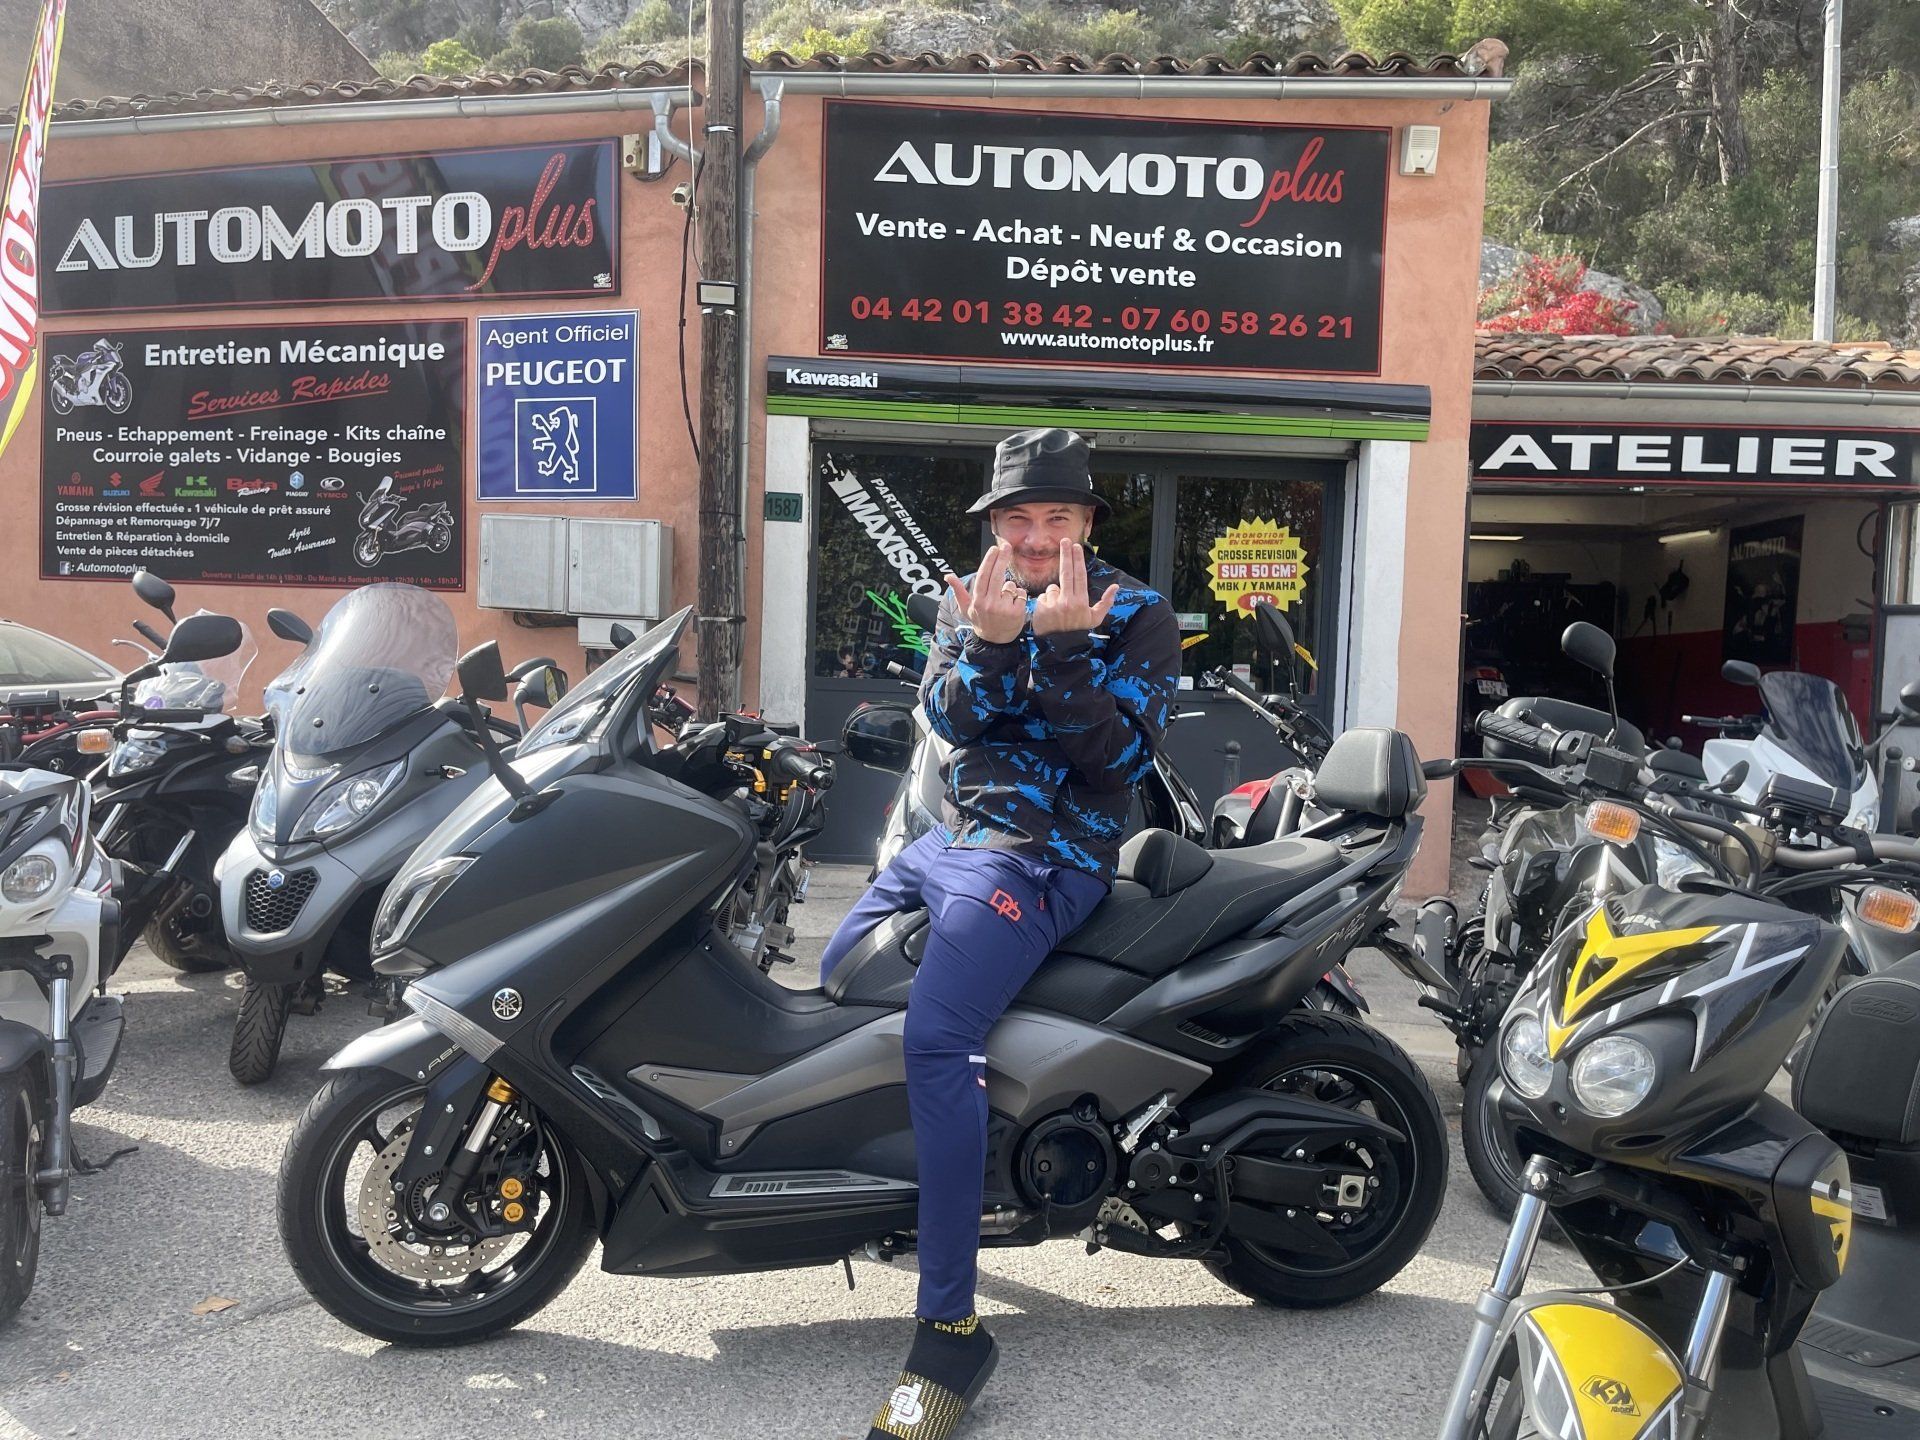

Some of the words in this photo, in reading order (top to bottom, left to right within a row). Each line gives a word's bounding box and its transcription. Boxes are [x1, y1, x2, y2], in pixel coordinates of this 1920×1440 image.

[873, 140, 1264, 201] AUTOMOTO
[1239, 136, 1343, 228] plus
[55, 191, 493, 273] AUTOMOTO
[463, 152, 597, 292] plus
[856, 212, 946, 240] Vente
[972, 219, 1063, 247] Achat
[1090, 223, 1165, 251] Neuf
[1174, 227, 1197, 253] &
[1205, 228, 1343, 259] Occasion
[1006, 254, 1103, 287] Dépôt
[1110, 262, 1197, 289] vente
[851, 296, 892, 321] 04
[901, 299, 943, 322] 42
[952, 300, 989, 324] 01
[1002, 302, 1042, 326] 38
[1052, 304, 1093, 328] 42
[1121, 306, 1160, 332] 07
[1170, 309, 1211, 334] 60
[1220, 311, 1259, 336] 58
[1269, 313, 1308, 338] 26
[1317, 315, 1354, 339] 21
[486, 328, 549, 349] Agent
[555, 323, 629, 343] Officiel
[1001, 330, 1215, 356] www.automotoplus.fr
[145, 341, 270, 366] Entretien
[280, 337, 445, 368] Mécanique
[486, 358, 627, 387] PEUGEOT
[786, 367, 879, 388] Kawasaki
[188, 389, 281, 415] Services
[291, 370, 391, 401] Rapides
[56, 427, 103, 442] Pneus
[118, 426, 233, 445] Echappement
[251, 426, 328, 444] Freinage
[346, 425, 380, 441] Kits
[387, 424, 446, 441] chaîne
[93, 448, 164, 463] Courroie
[169, 448, 221, 467] galets
[237, 448, 310, 467] Vidange
[328, 448, 402, 467] Bougies
[1479, 434, 1897, 478] ATELIER
[57, 485, 95, 497] YAMAHA
[103, 489, 131, 497] SUZUKI
[175, 487, 217, 498] Kawasaki
[56, 503, 90, 513] Grosse
[93, 503, 133, 513] révision
[135, 502, 185, 514] effectuée
[194, 504, 200, 513] 1
[204, 504, 248, 514] véhicule
[251, 505, 266, 514] de
[269, 504, 292, 518] prêt
[295, 505, 331, 515] assuré
[768, 498, 799, 517] 1587
[56, 516, 114, 529] Dépannage
[117, 518, 127, 526] et
[130, 517, 197, 529] Remorquage
[200, 517, 221, 530] 7j/7
[870, 477, 938, 555] PARTENAIRE
[931, 558, 955, 573] AV
[56, 531, 102, 542] Entretien
[105, 532, 113, 541] &
[117, 531, 173, 544] Réparation
[176, 533, 183, 543] à
[185, 533, 230, 543] domicile
[267, 549, 292, 559] Toutes
[294, 537, 336, 553] Assurances
[840, 490, 945, 601] MAXISCO
[57, 546, 87, 556] Vente
[89, 546, 102, 556] de
[106, 546, 138, 558] pièces
[141, 546, 194, 558] détachées
[1217, 549, 1254, 560] GROSSE
[1256, 549, 1298, 560] REVISION
[1221, 564, 1248, 578] SUR
[1251, 564, 1269, 578] 50
[1217, 582, 1239, 591] MBK
[1251, 582, 1297, 591] YAMAHA
[428, 1042, 461, 1071] ABS
